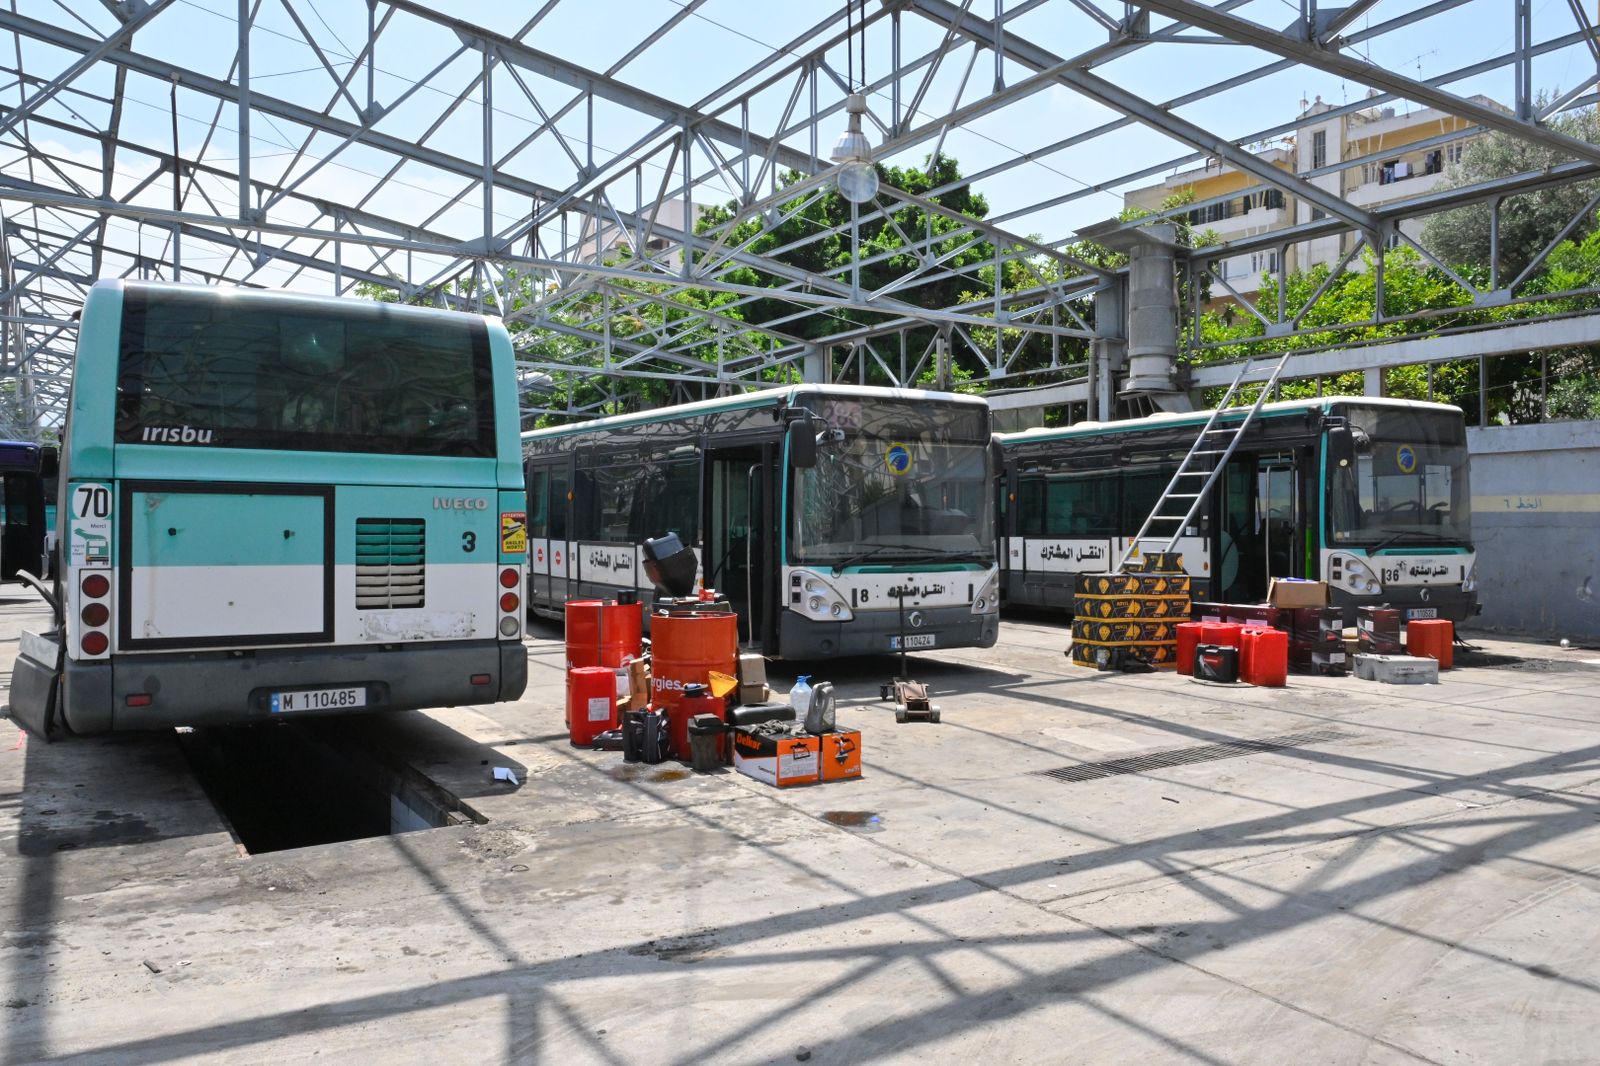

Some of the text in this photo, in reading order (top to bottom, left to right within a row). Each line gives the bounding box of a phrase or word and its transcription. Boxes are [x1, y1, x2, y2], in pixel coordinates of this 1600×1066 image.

[78, 487, 109, 518] 70
[433, 496, 488, 510] IVECO
[462, 531, 476, 553] 3
[1041, 544, 1073, 561] المشترك
[1386, 569, 1400, 582] 36
[860, 589, 869, 602] 8
[283, 690, 356, 710] M 110485
